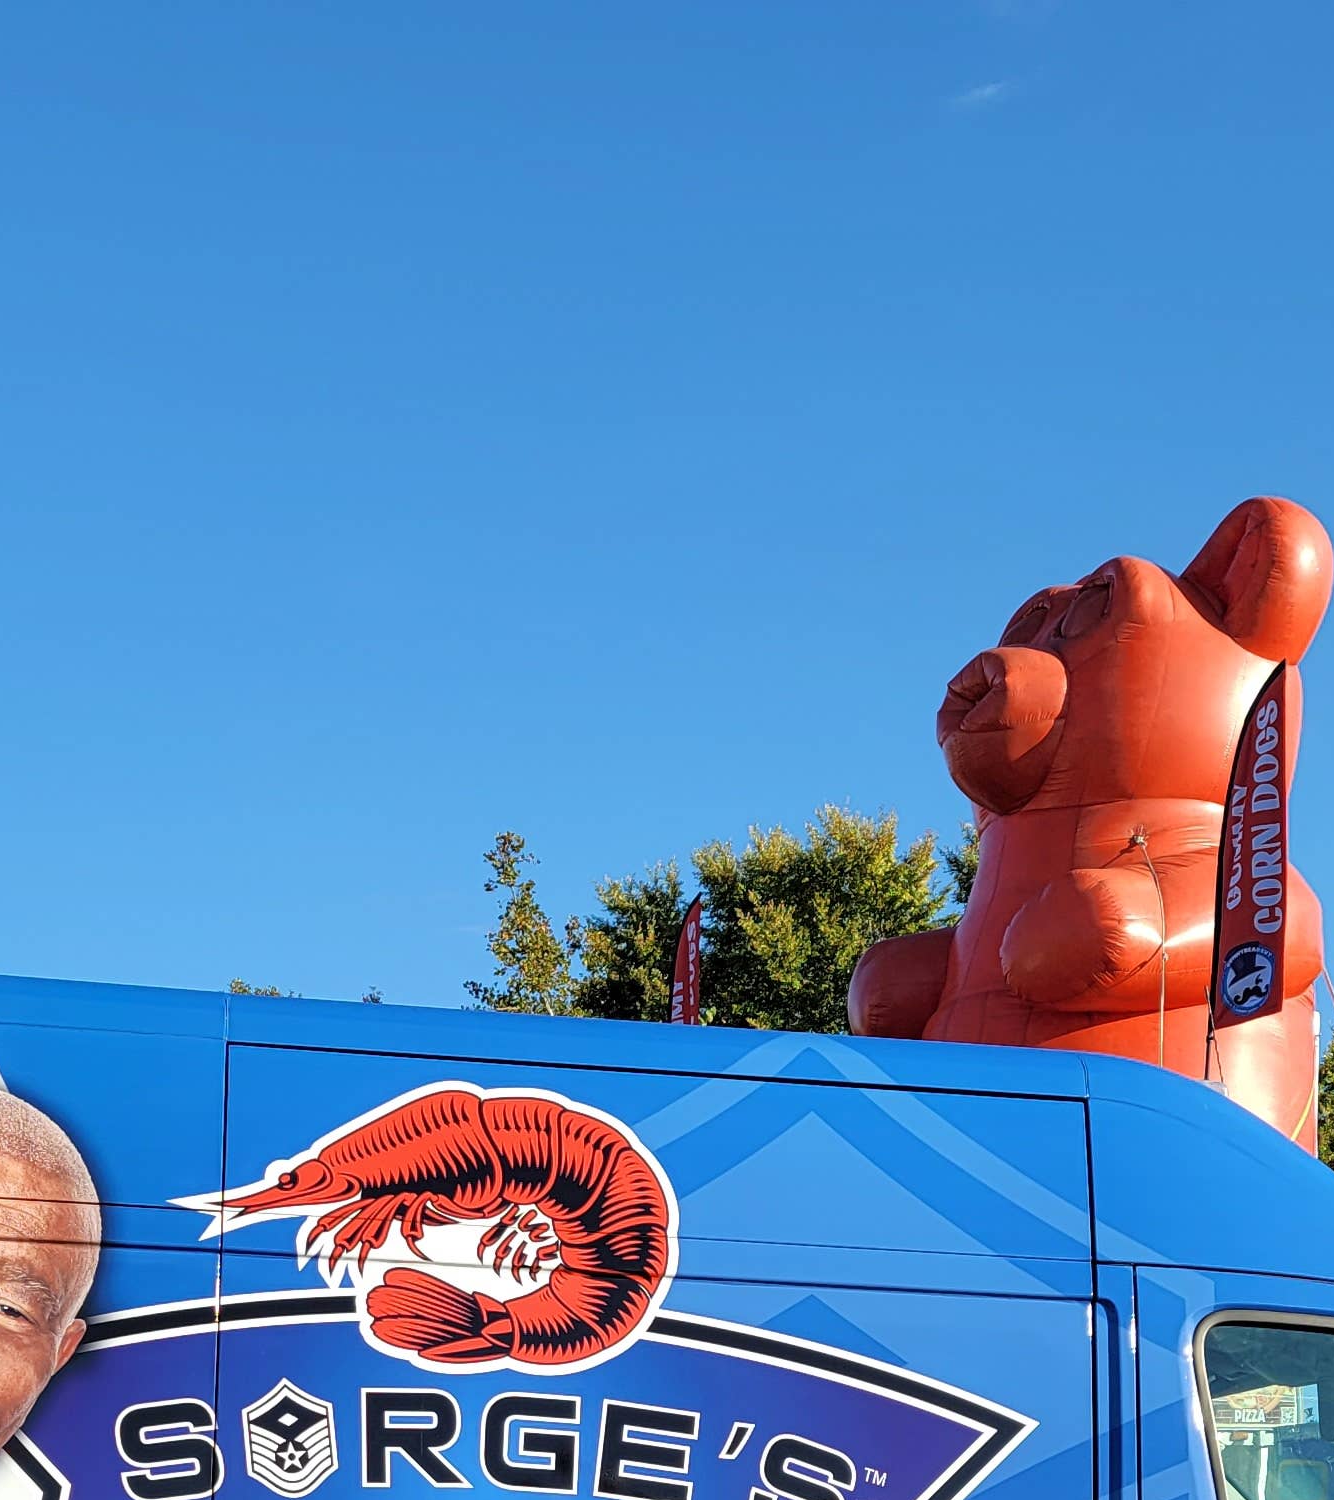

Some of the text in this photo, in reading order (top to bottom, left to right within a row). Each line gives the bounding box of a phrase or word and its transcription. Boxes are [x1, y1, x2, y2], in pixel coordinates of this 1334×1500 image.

[1251, 699, 1283, 934] CORN DOGS
[1234, 1408, 1266, 1423] PIZZA
